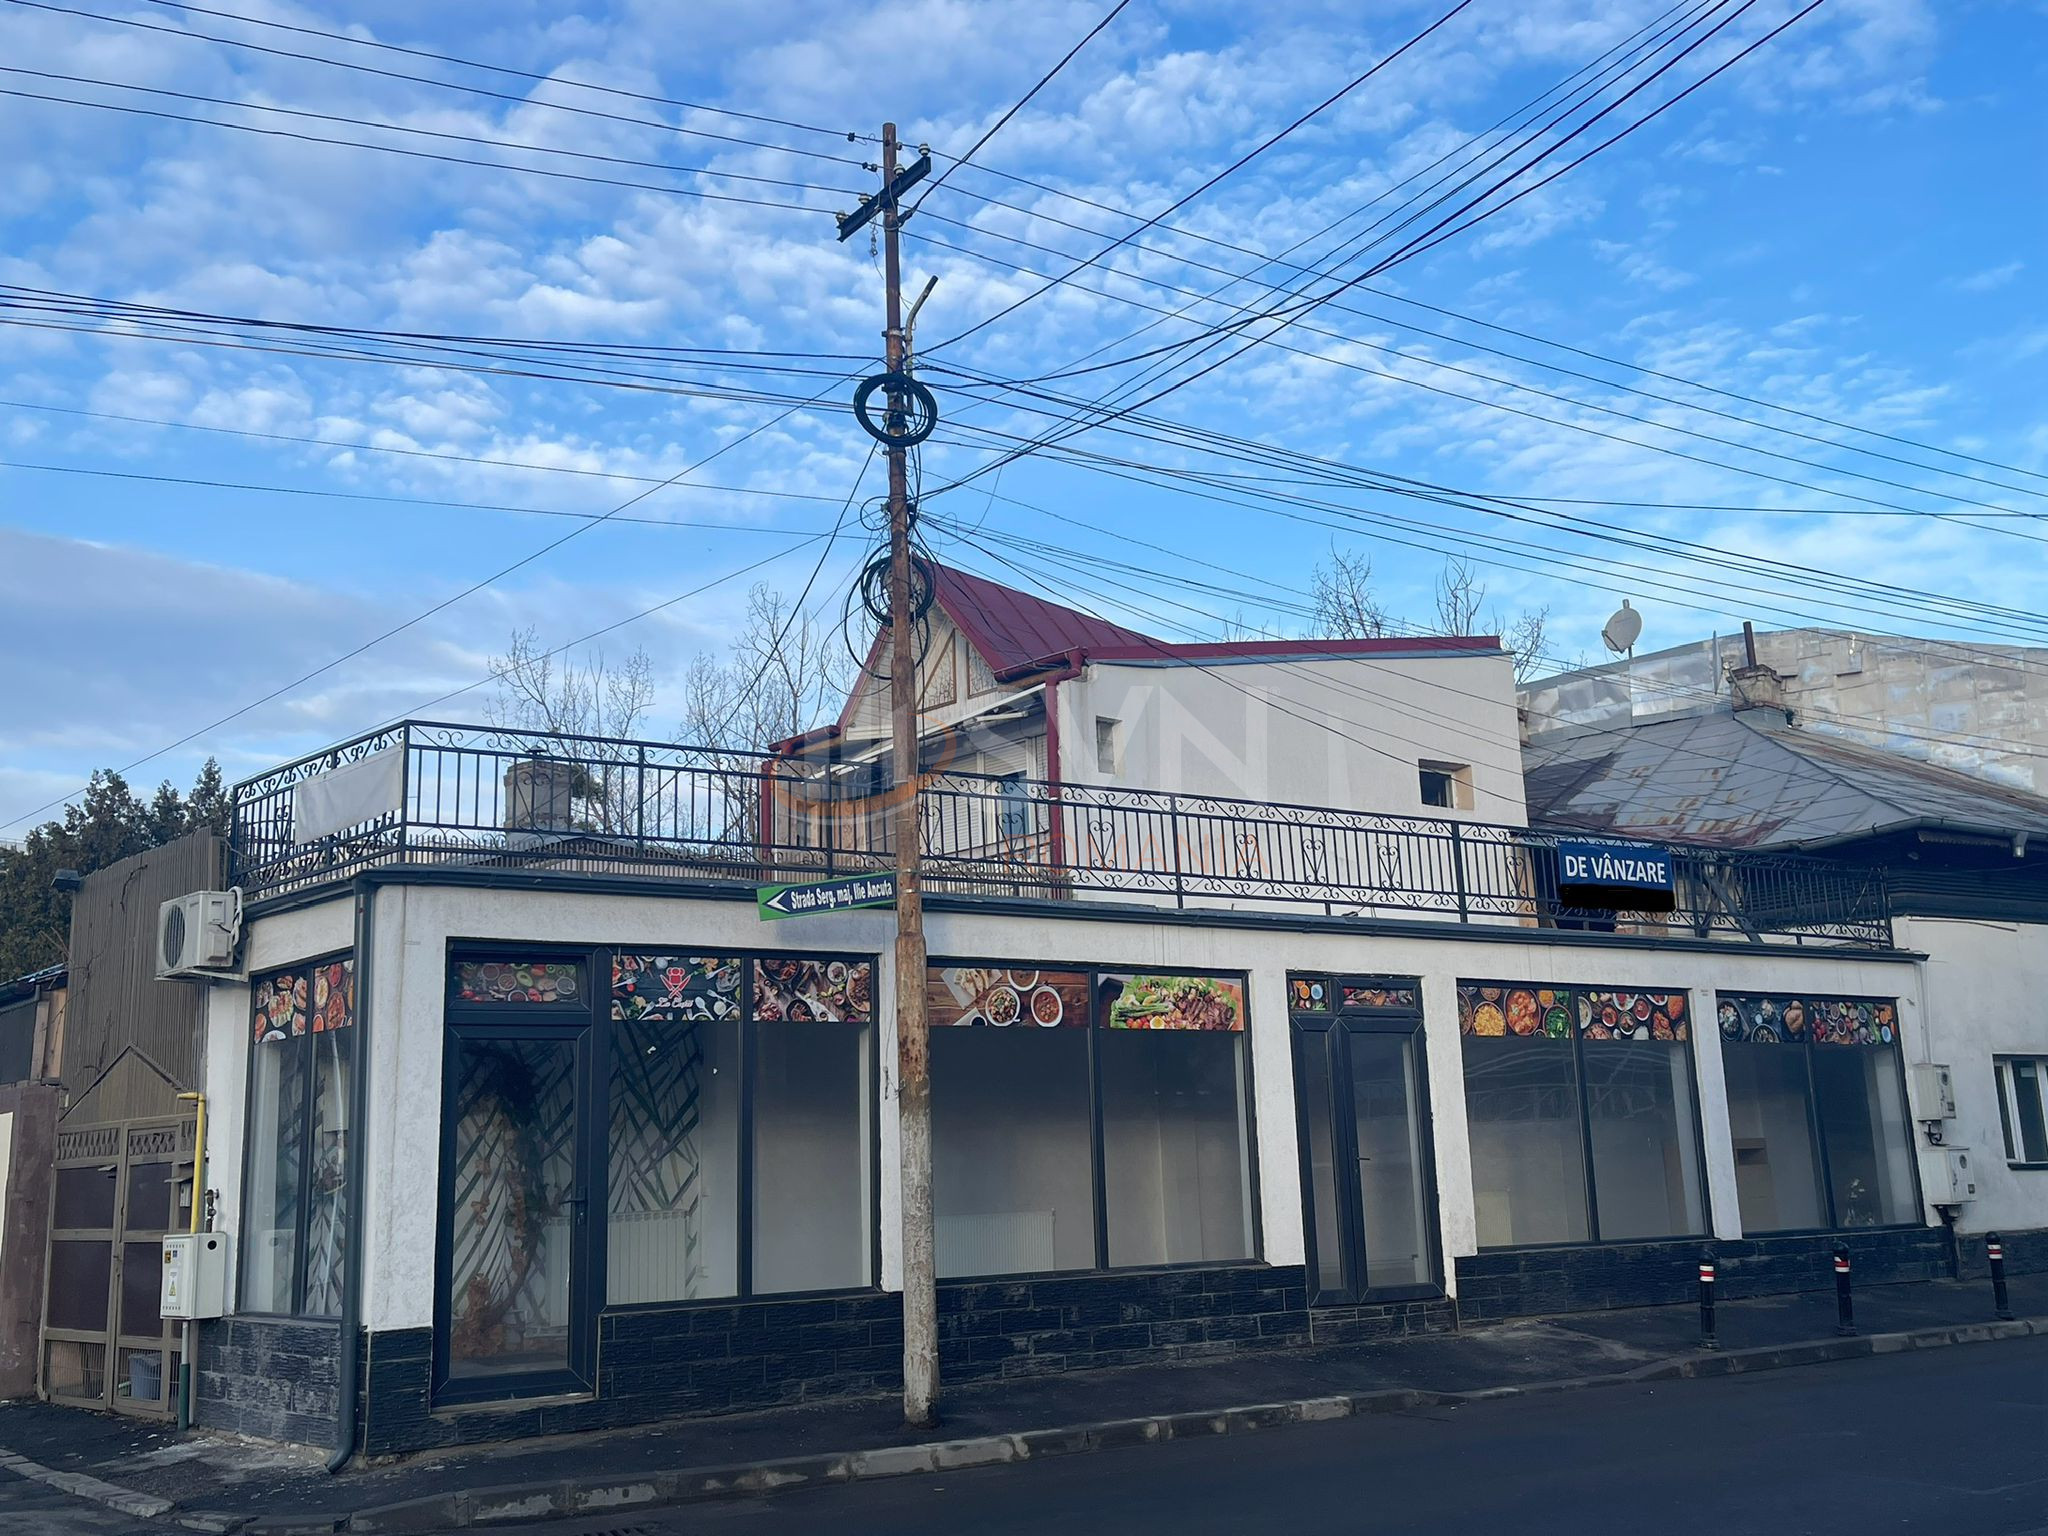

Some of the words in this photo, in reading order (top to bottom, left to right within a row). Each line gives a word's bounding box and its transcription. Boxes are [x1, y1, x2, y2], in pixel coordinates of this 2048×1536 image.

[1565, 855, 1588, 878] DE
[1591, 853, 1667, 883] VÂNZARE
[791, 890, 816, 909] Strada
[816, 888, 836, 908] Serg.
[837, 884, 853, 905] maj.
[853, 883, 866, 900] Ilie
